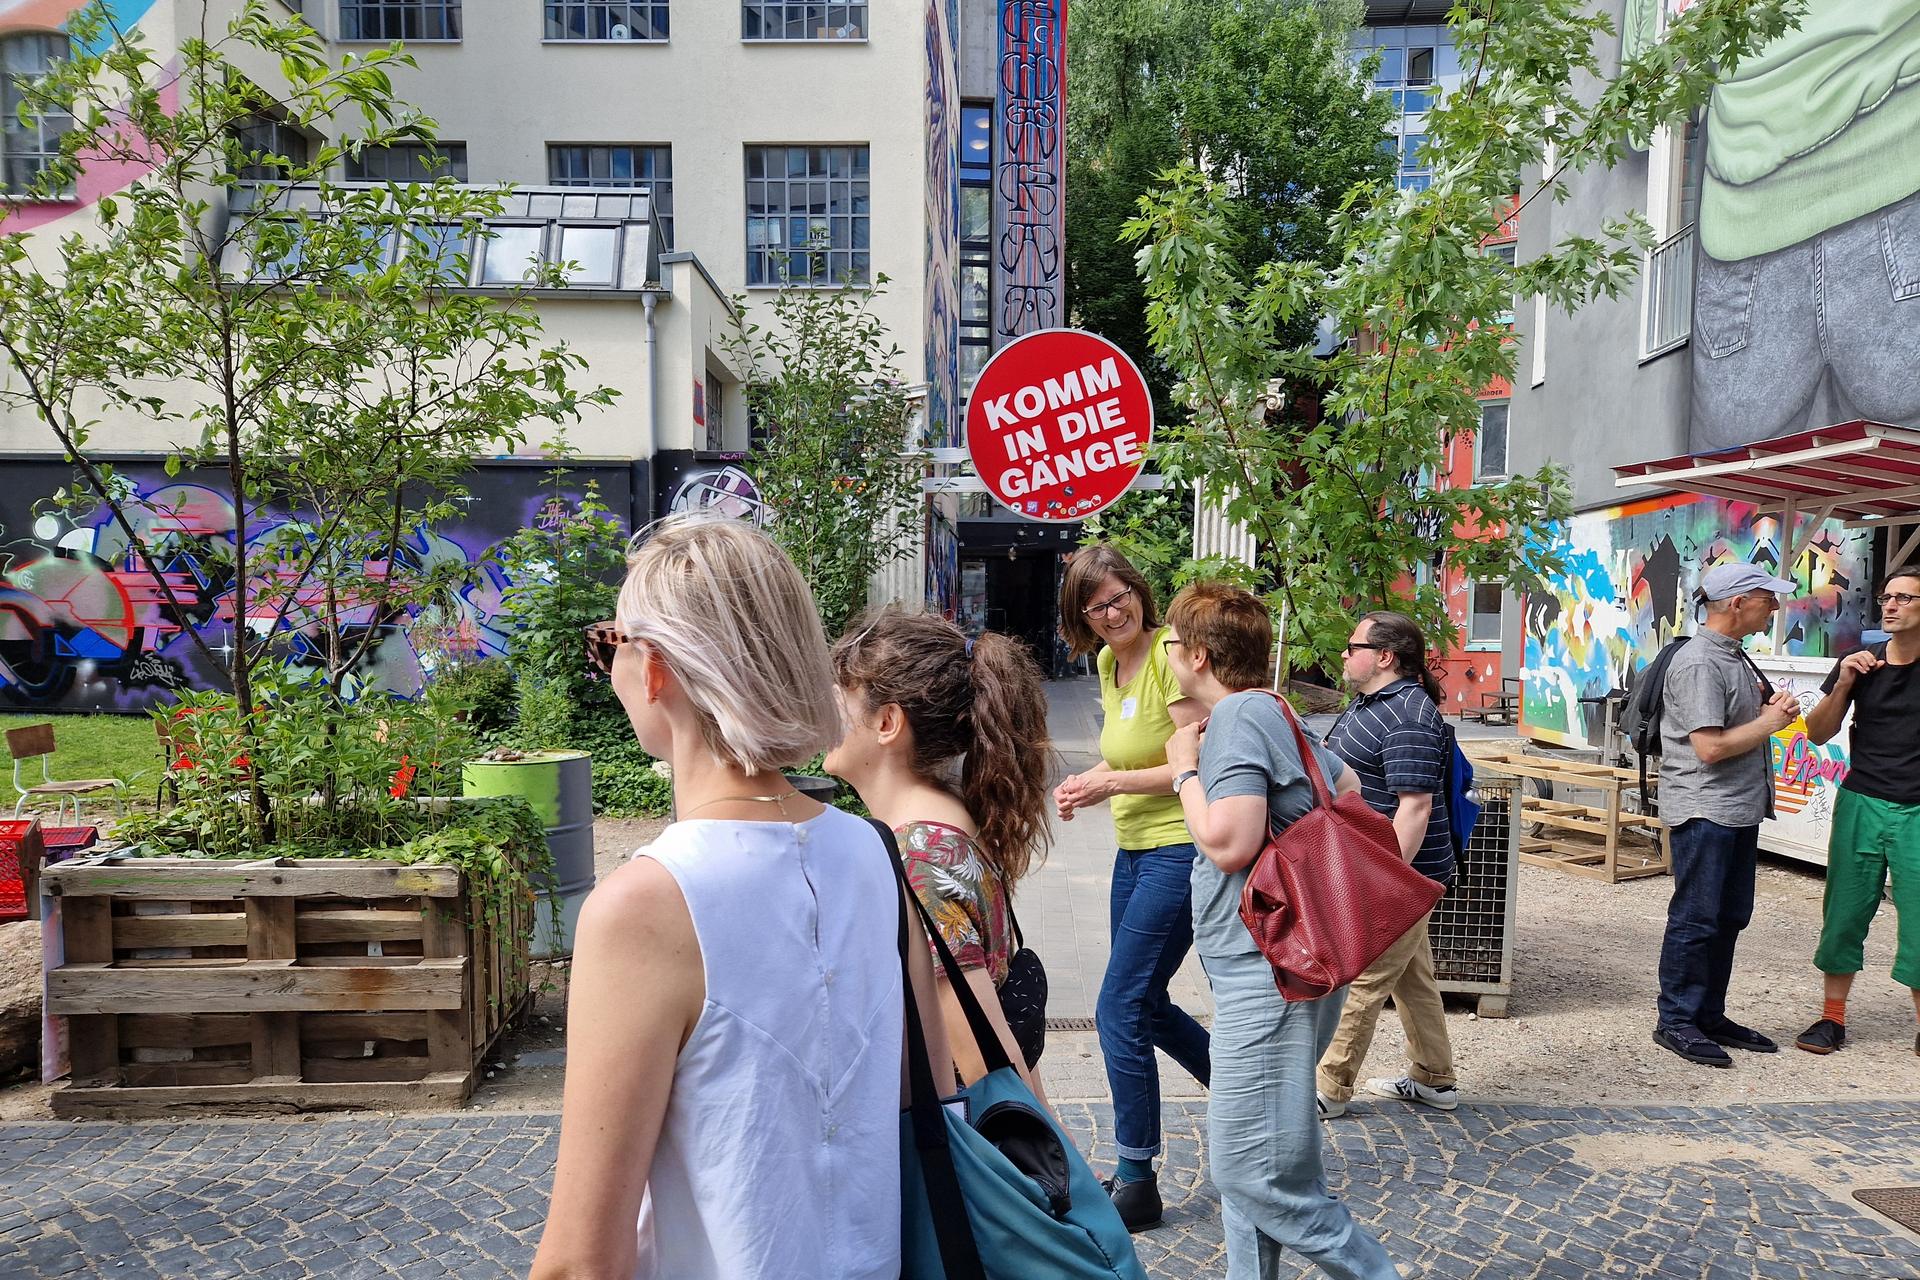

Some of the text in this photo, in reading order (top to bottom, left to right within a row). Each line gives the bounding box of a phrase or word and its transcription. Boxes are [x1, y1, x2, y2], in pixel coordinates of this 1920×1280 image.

[983, 356, 1122, 431] KOMM
[1003, 397, 1126, 462] IN DIE
[999, 432, 1143, 498] GÄNGE
[1781, 732, 1849, 795] Open
